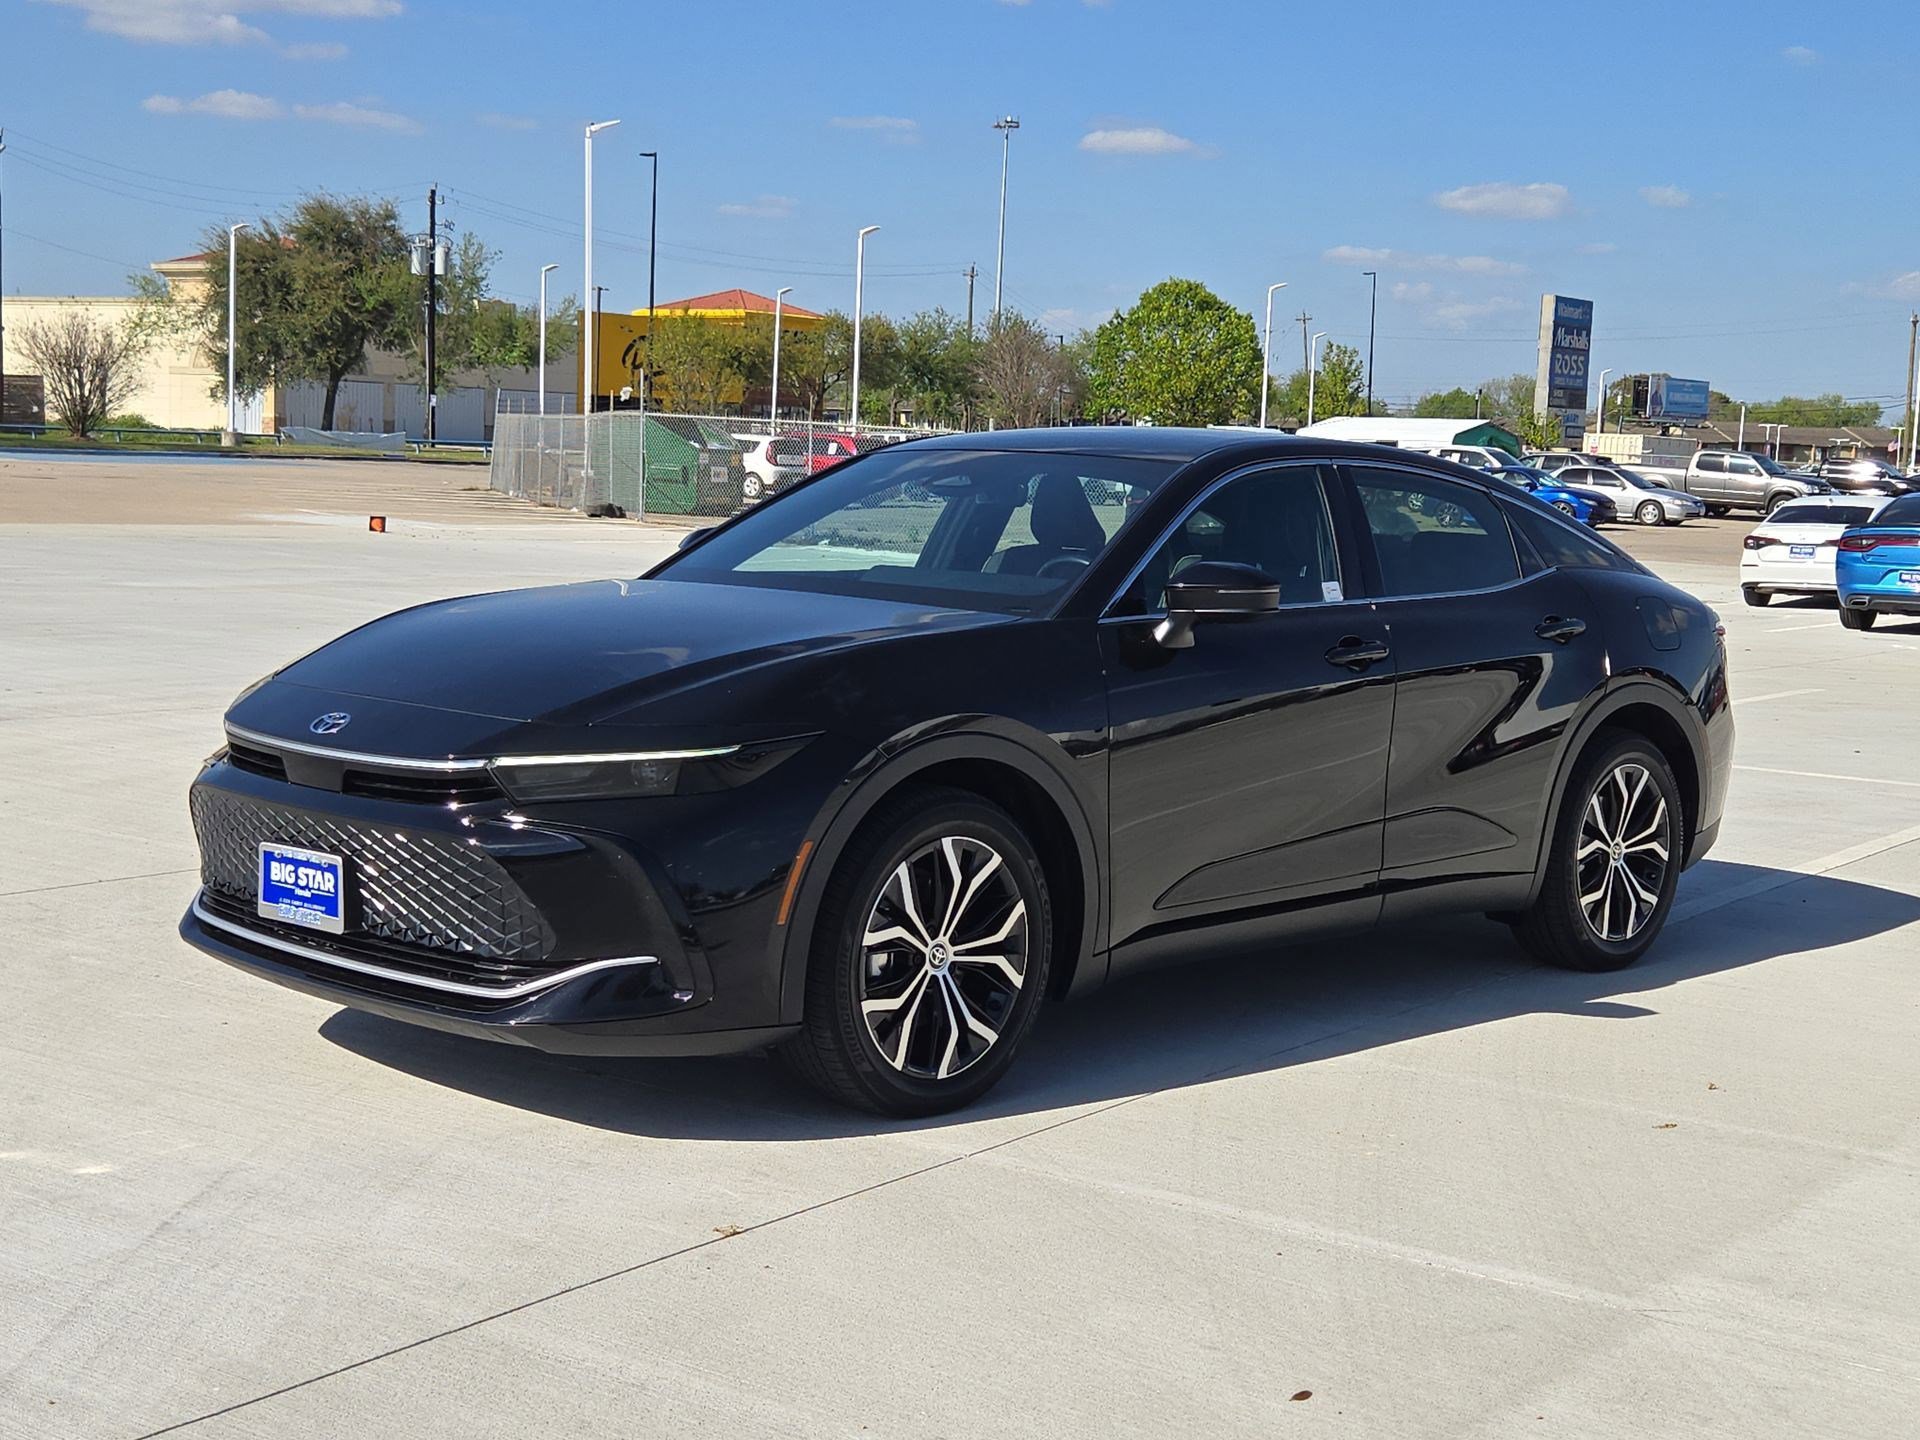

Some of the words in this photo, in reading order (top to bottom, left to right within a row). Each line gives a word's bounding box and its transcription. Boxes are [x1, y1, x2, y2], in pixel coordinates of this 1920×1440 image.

[1554, 326, 1589, 350] Marshalls
[1554, 353, 1585, 376] ROSS
[270, 861, 296, 884] BIG
[297, 866, 335, 893] STAR
